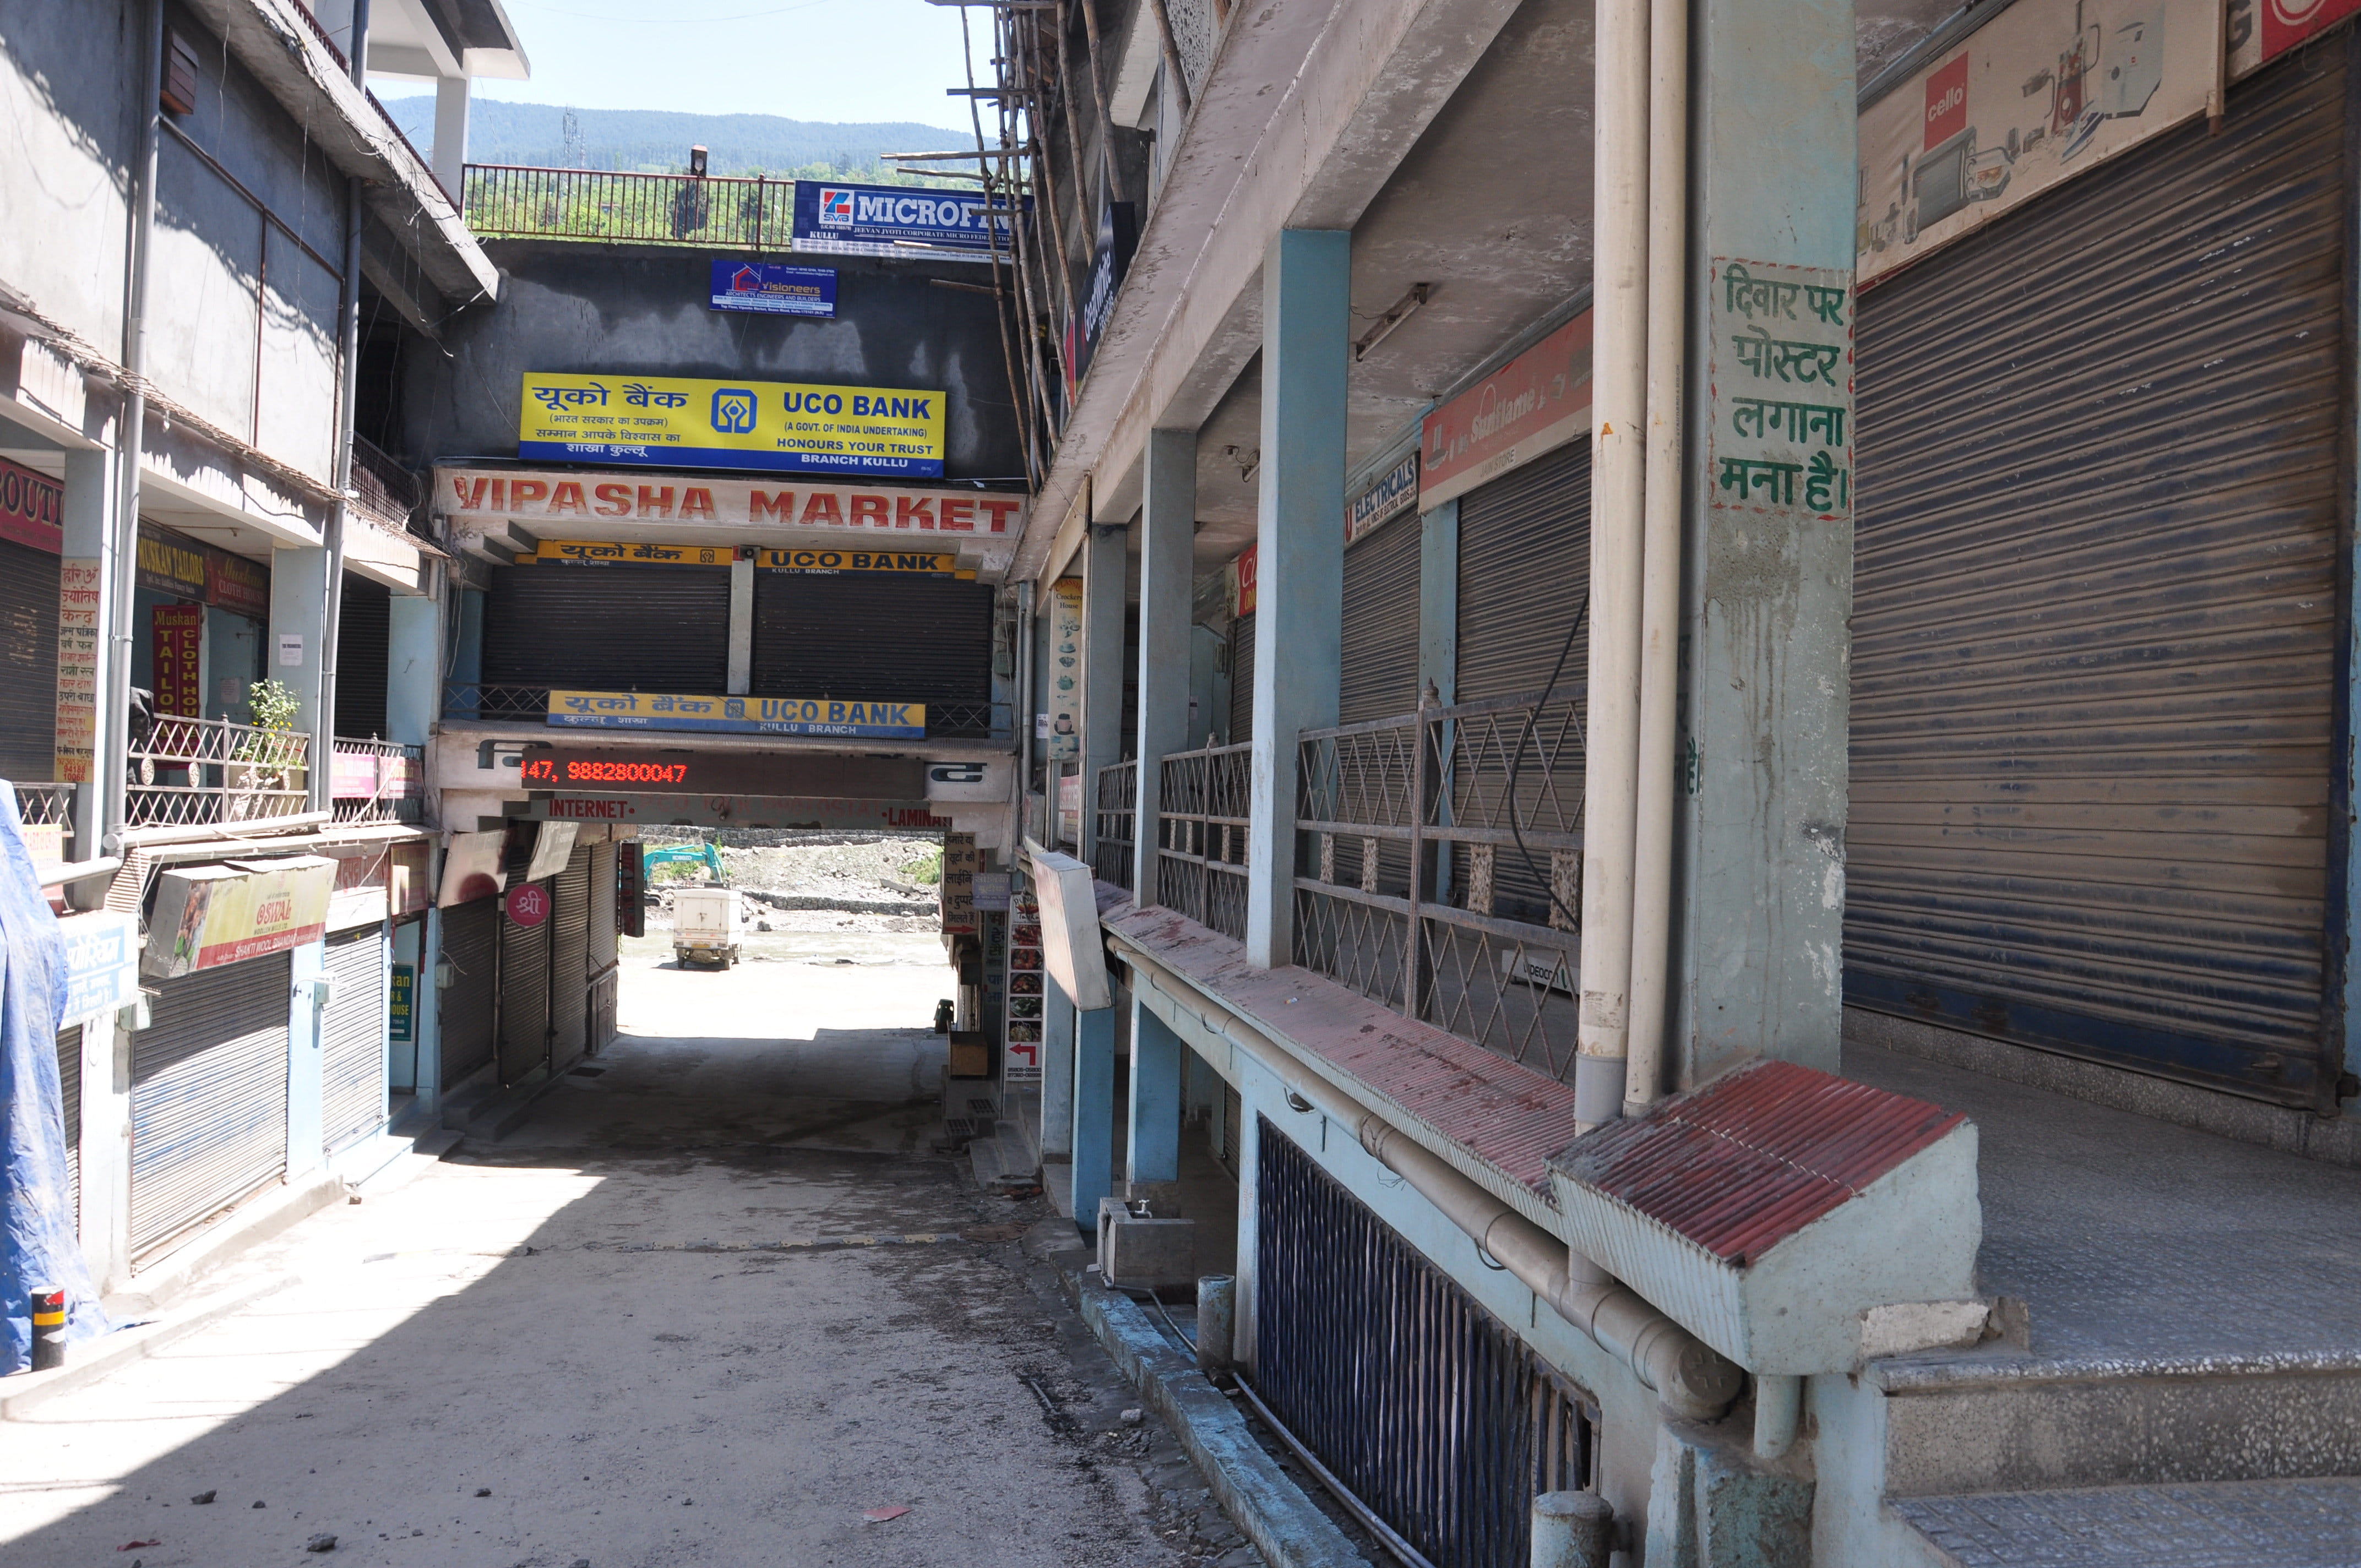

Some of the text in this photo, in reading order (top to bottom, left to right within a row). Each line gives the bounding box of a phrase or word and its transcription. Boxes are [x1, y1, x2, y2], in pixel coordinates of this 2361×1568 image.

[1928, 86, 1963, 122] cello
[809, 231, 839, 239] KULLU
[903, 230, 945, 238] CORPORATE
[971, 233, 1010, 242] FEDETIO
[762, 282, 820, 294] Visioneers
[1084, 251, 1112, 342] GreatWhite
[1722, 263, 1846, 326] दिवार पर
[1731, 324, 1841, 388] पोस्टर
[532, 382, 689, 411] यूको बैंक
[784, 392, 931, 420] UCO BANK
[550, 413, 668, 427] (भारत सरकार का उपक्रम)
[1471, 386, 1536, 443] Sunflame
[1731, 396, 1846, 447] लगाना
[536, 429, 681, 442] सम्मान आपके विश्वास का
[785, 422, 927, 439] (A GOVT. OF INDIA UNDERTAKING)
[566, 443, 648, 458] शाखा कुल्लू
[777, 438, 933, 455] HONOURS YOUR TRUST
[801, 454, 908, 467] BRANCH KULLU
[1494, 449, 1515, 470] STORE
[1355, 458, 1415, 523] ELECTRICALS
[1718, 456, 1804, 505] मना
[0, 469, 64, 530] OUTI
[453, 476, 1021, 533] VIPASHA MARKET
[138, 536, 204, 586] MUSKAN TAILORS
[560, 544, 683, 560] यूको बैंक
[771, 551, 939, 570] UCO BANK
[62, 563, 81, 584] हरि
[61, 586, 100, 604] ज्योतिष
[219, 580, 265, 604] CLOTH HOUSE
[155, 611, 197, 626] Muskan
[182, 629, 197, 680] CLOTH
[182, 687, 198, 738] HOUE
[564, 694, 714, 714] यूको बैंक
[761, 699, 910, 725] UCO BANK
[760, 722, 856, 734] KULLU BRANCH
[567, 761, 688, 783] 9882800047
[548, 798, 628, 819] INTERNET
[946, 832, 964, 846] हमारे
[949, 850, 975, 866] सूटों की
[946, 869, 973, 886] लाईनिं
[515, 890, 542, 915] श्री
[947, 896, 953, 905] व
[257, 900, 292, 925] OSWAL
[948, 911, 968, 924] मिलते
[235, 943, 257, 959] SHAKTI
[256, 940, 273, 954] WOOL
[390, 1004, 409, 1016] OUSE
